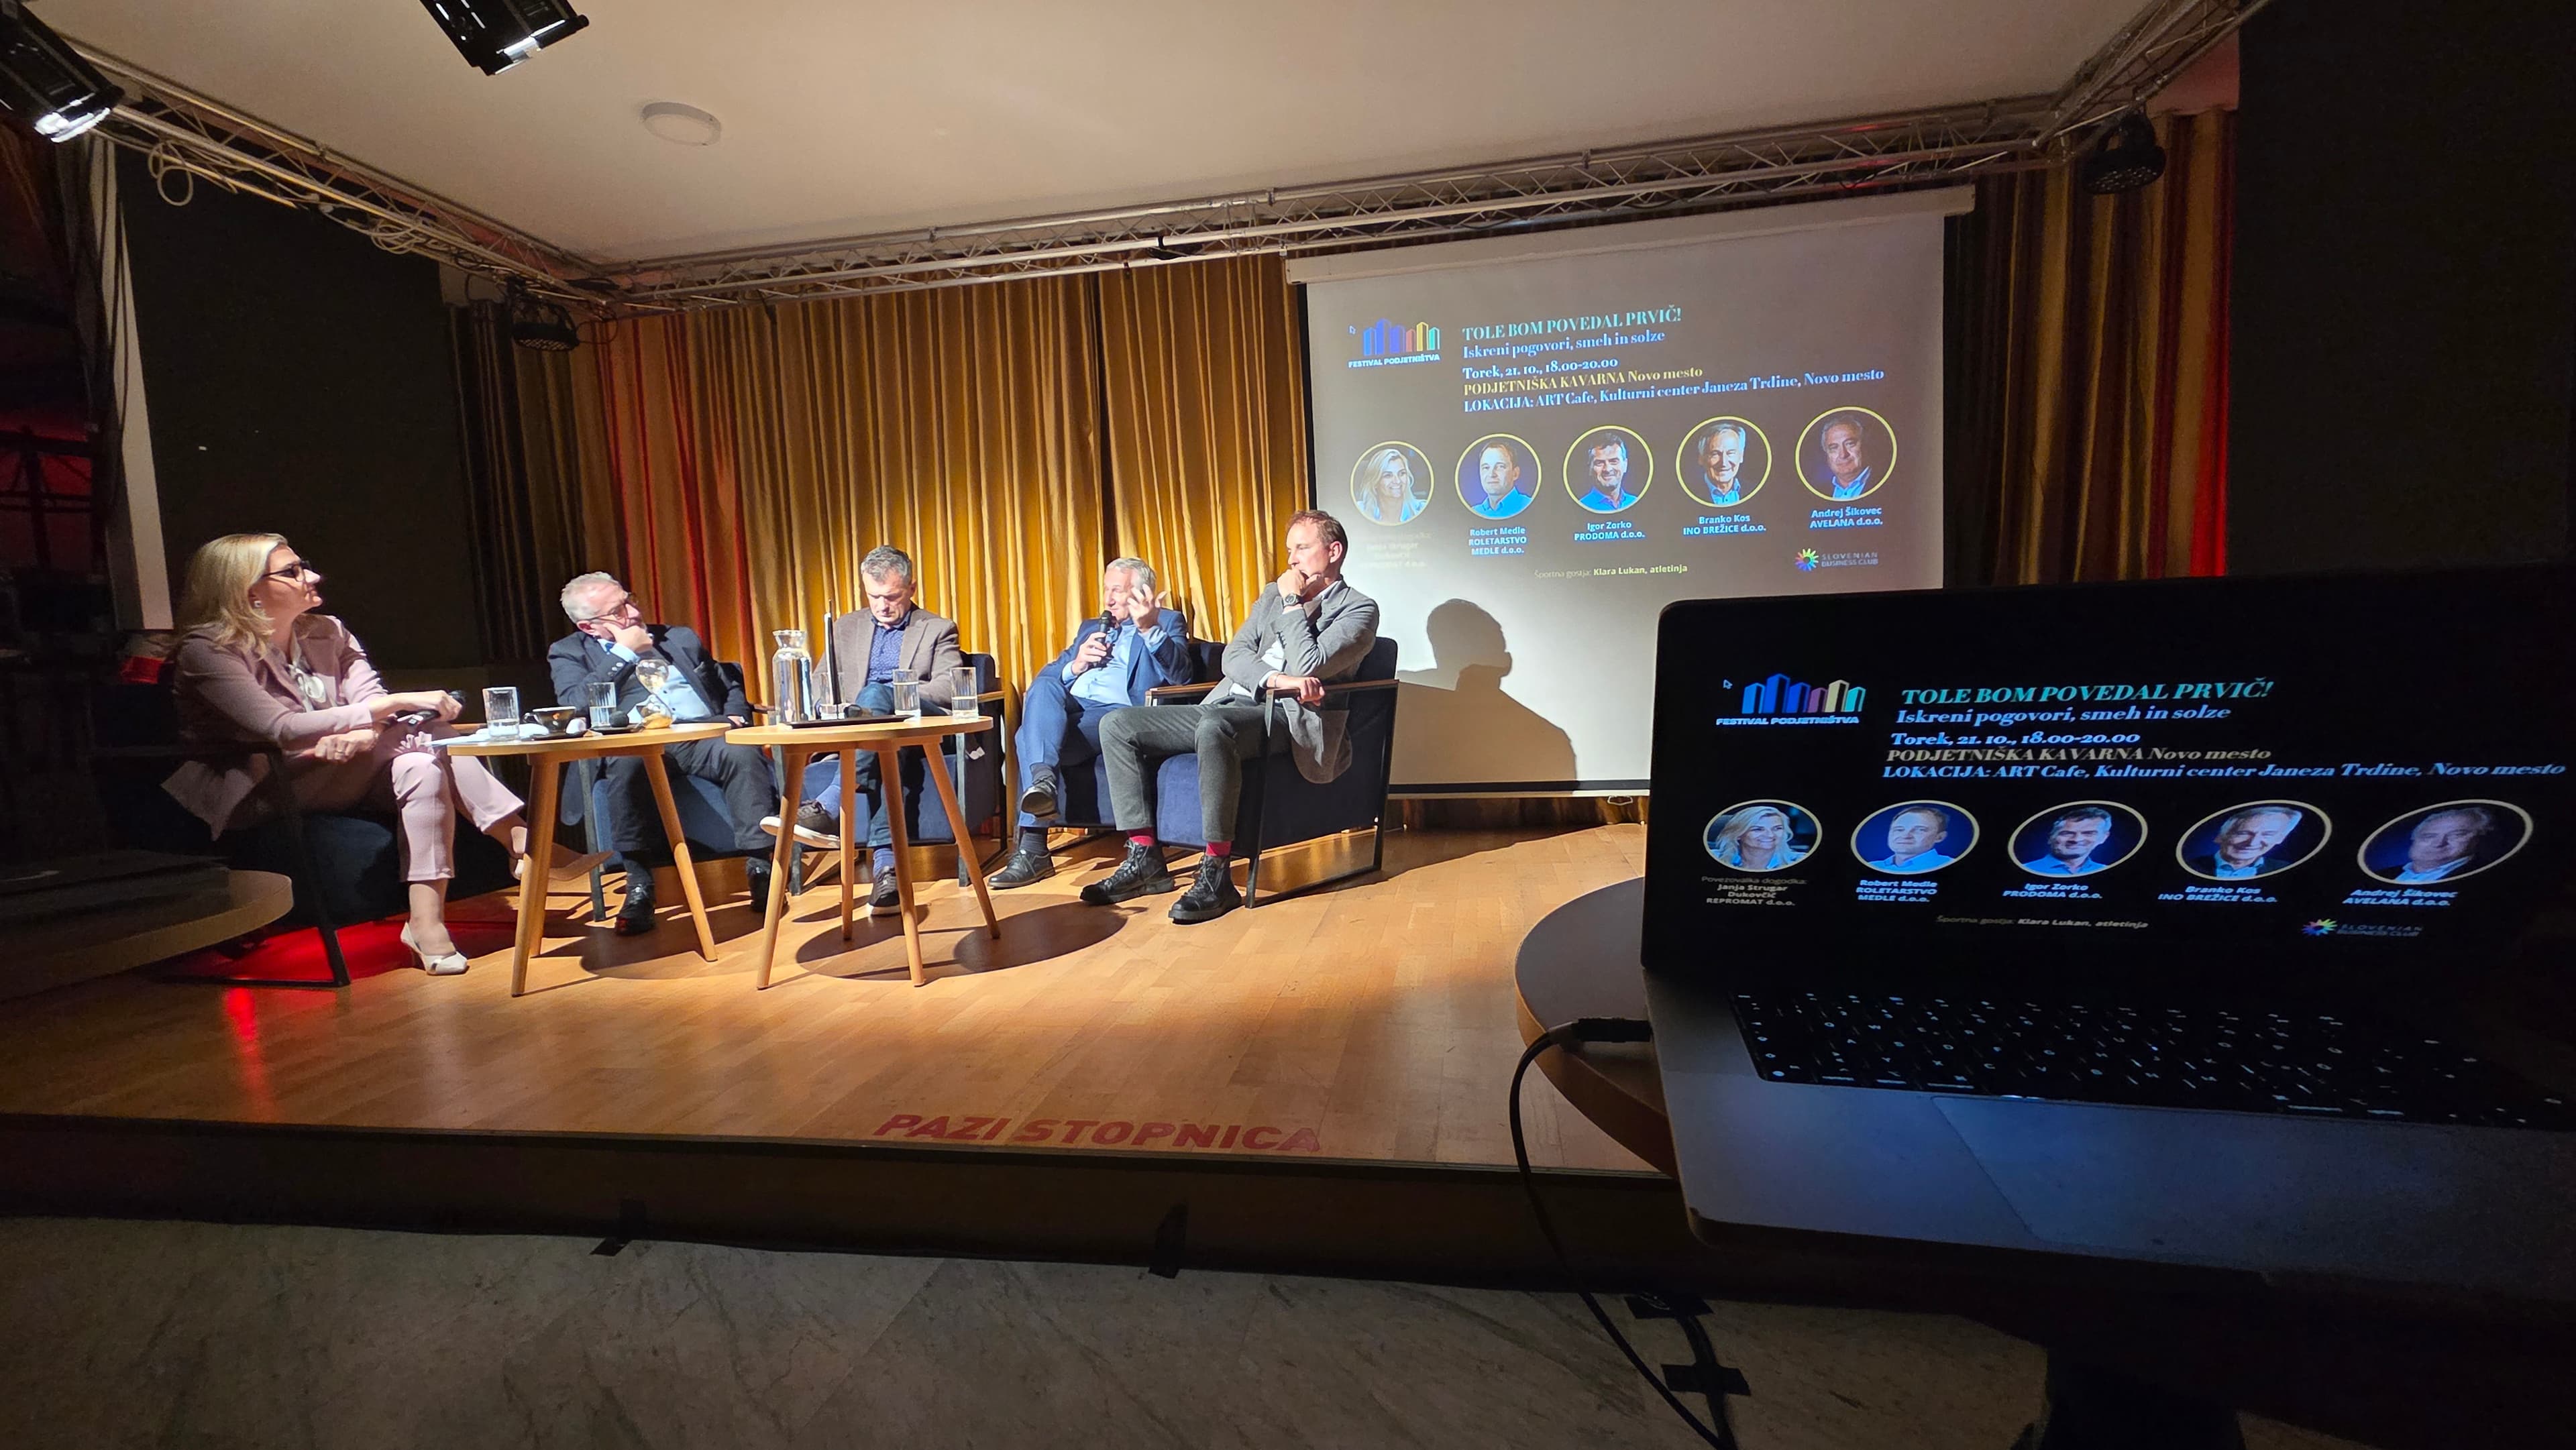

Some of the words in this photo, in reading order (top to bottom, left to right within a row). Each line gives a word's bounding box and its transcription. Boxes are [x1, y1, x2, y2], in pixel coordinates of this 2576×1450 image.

[1462, 325, 1505, 341] TOLE
[1509, 321, 1543, 337] BOM
[1546, 313, 1623, 334] POVEDAL
[1626, 304, 1682, 327] PRVIČ!
[1463, 342, 1509, 359] Iskreni
[1512, 337, 1574, 359] pogovori,
[1576, 333, 1612, 349] smeh
[1615, 332, 1629, 345] in
[1631, 329, 1666, 343] solze
[1348, 359, 1383, 368] FESTIVAL
[1462, 365, 1503, 380] Torek,
[1505, 368, 1521, 377] 21.
[1523, 366, 1543, 376] 10.,
[1546, 359, 1619, 374] 18.00-20.00
[1464, 376, 1558, 396] PODJETNIŠKA
[1560, 371, 1625, 388] KAVARNA
[1627, 370, 1661, 383] Novo
[1664, 367, 1703, 380] mesto
[1464, 396, 1534, 412] LOKACIJA:
[1536, 394, 1564, 407] ART
[1565, 391, 1598, 404] Cafe,
[1600, 386, 1655, 402] Kulturni
[1657, 385, 1701, 397] center
[1701, 381, 1748, 394] Janeza
[1750, 375, 1802, 390] Trdine,
[1804, 372, 1839, 386] Novo
[1842, 369, 1884, 382] mesto
[1811, 508, 1844, 518] Andrej
[1845, 506, 1882, 516] Šikovec
[1699, 515, 1732, 524] Branko
[1733, 514, 1750, 523] Kos
[1810, 518, 1856, 528] AVELANA
[1856, 518, 1884, 526] d.o.o.
[1587, 522, 1605, 532] Igor
[1606, 521, 1632, 530] Zorko
[1683, 526, 1701, 535] INO
[1703, 523, 1739, 535] BREŽICE
[1741, 523, 1766, 533] d.o.o.
[1470, 528, 1498, 537] Robert
[1574, 532, 1619, 541] PRODOMA
[1620, 531, 1646, 539] d.o.o.
[1468, 537, 1527, 546] ROLETARSTVO
[1471, 547, 1499, 555] MEDLE
[1501, 546, 1525, 555] d.o.o.
[1821, 552, 1879, 561] SLOVENIAN
[1593, 567, 1617, 576] Klara
[1618, 567, 1648, 575] Lukan,
[1650, 564, 1688, 575] atletinja
[1901, 688, 1972, 704] TOLE
[1974, 687, 2037, 703] BOM
[2039, 684, 2169, 702] POVEDAL
[2171, 677, 2275, 700] PRVIČ!
[1896, 708, 1974, 723] Iskreni
[1974, 707, 2076, 726] pogovori,
[2080, 706, 2141, 720] smeh
[2145, 706, 2169, 720] in
[2171, 704, 2231, 719] solze
[1891, 732, 1953, 746] Torek,
[1956, 736, 1982, 744] 21.
[1985, 736, 2017, 745] 10.,
[2021, 731, 2141, 744] 18.00-20.00
[1886, 746, 2035, 762] PODJETNIŠKA
[2039, 748, 2144, 761] KAVARNA
[2147, 748, 2202, 760] Novo
[2204, 748, 2271, 760] mesto
[1882, 765, 1991, 778] LOKACIJA:
[1993, 765, 2041, 777] ART
[2041, 765, 2090, 779] Cafe,
[2094, 765, 2186, 777] Kulturni
[2186, 765, 2257, 777] center
[2258, 765, 2335, 776] Janeza
[2341, 763, 2422, 777] Trdine,
[2426, 763, 2489, 775] Novo
[2491, 764, 2566, 775] mesto
[1856, 887, 1937, 895] ROLETARSTVO
[2024, 883, 2050, 891] Igor
[2185, 886, 2233, 894] Branko
[2002, 890, 2066, 898] PRODOMA
[2186, 893, 2241, 902] BREŽICE
[2241, 895, 2278, 903] d.o.o.
[2350, 889, 2401, 898] Andrej
[2343, 897, 2410, 905] AVELANA
[872, 1114, 1013, 1141] PAZI
[1013, 1118, 1321, 1152] STOPNICA
